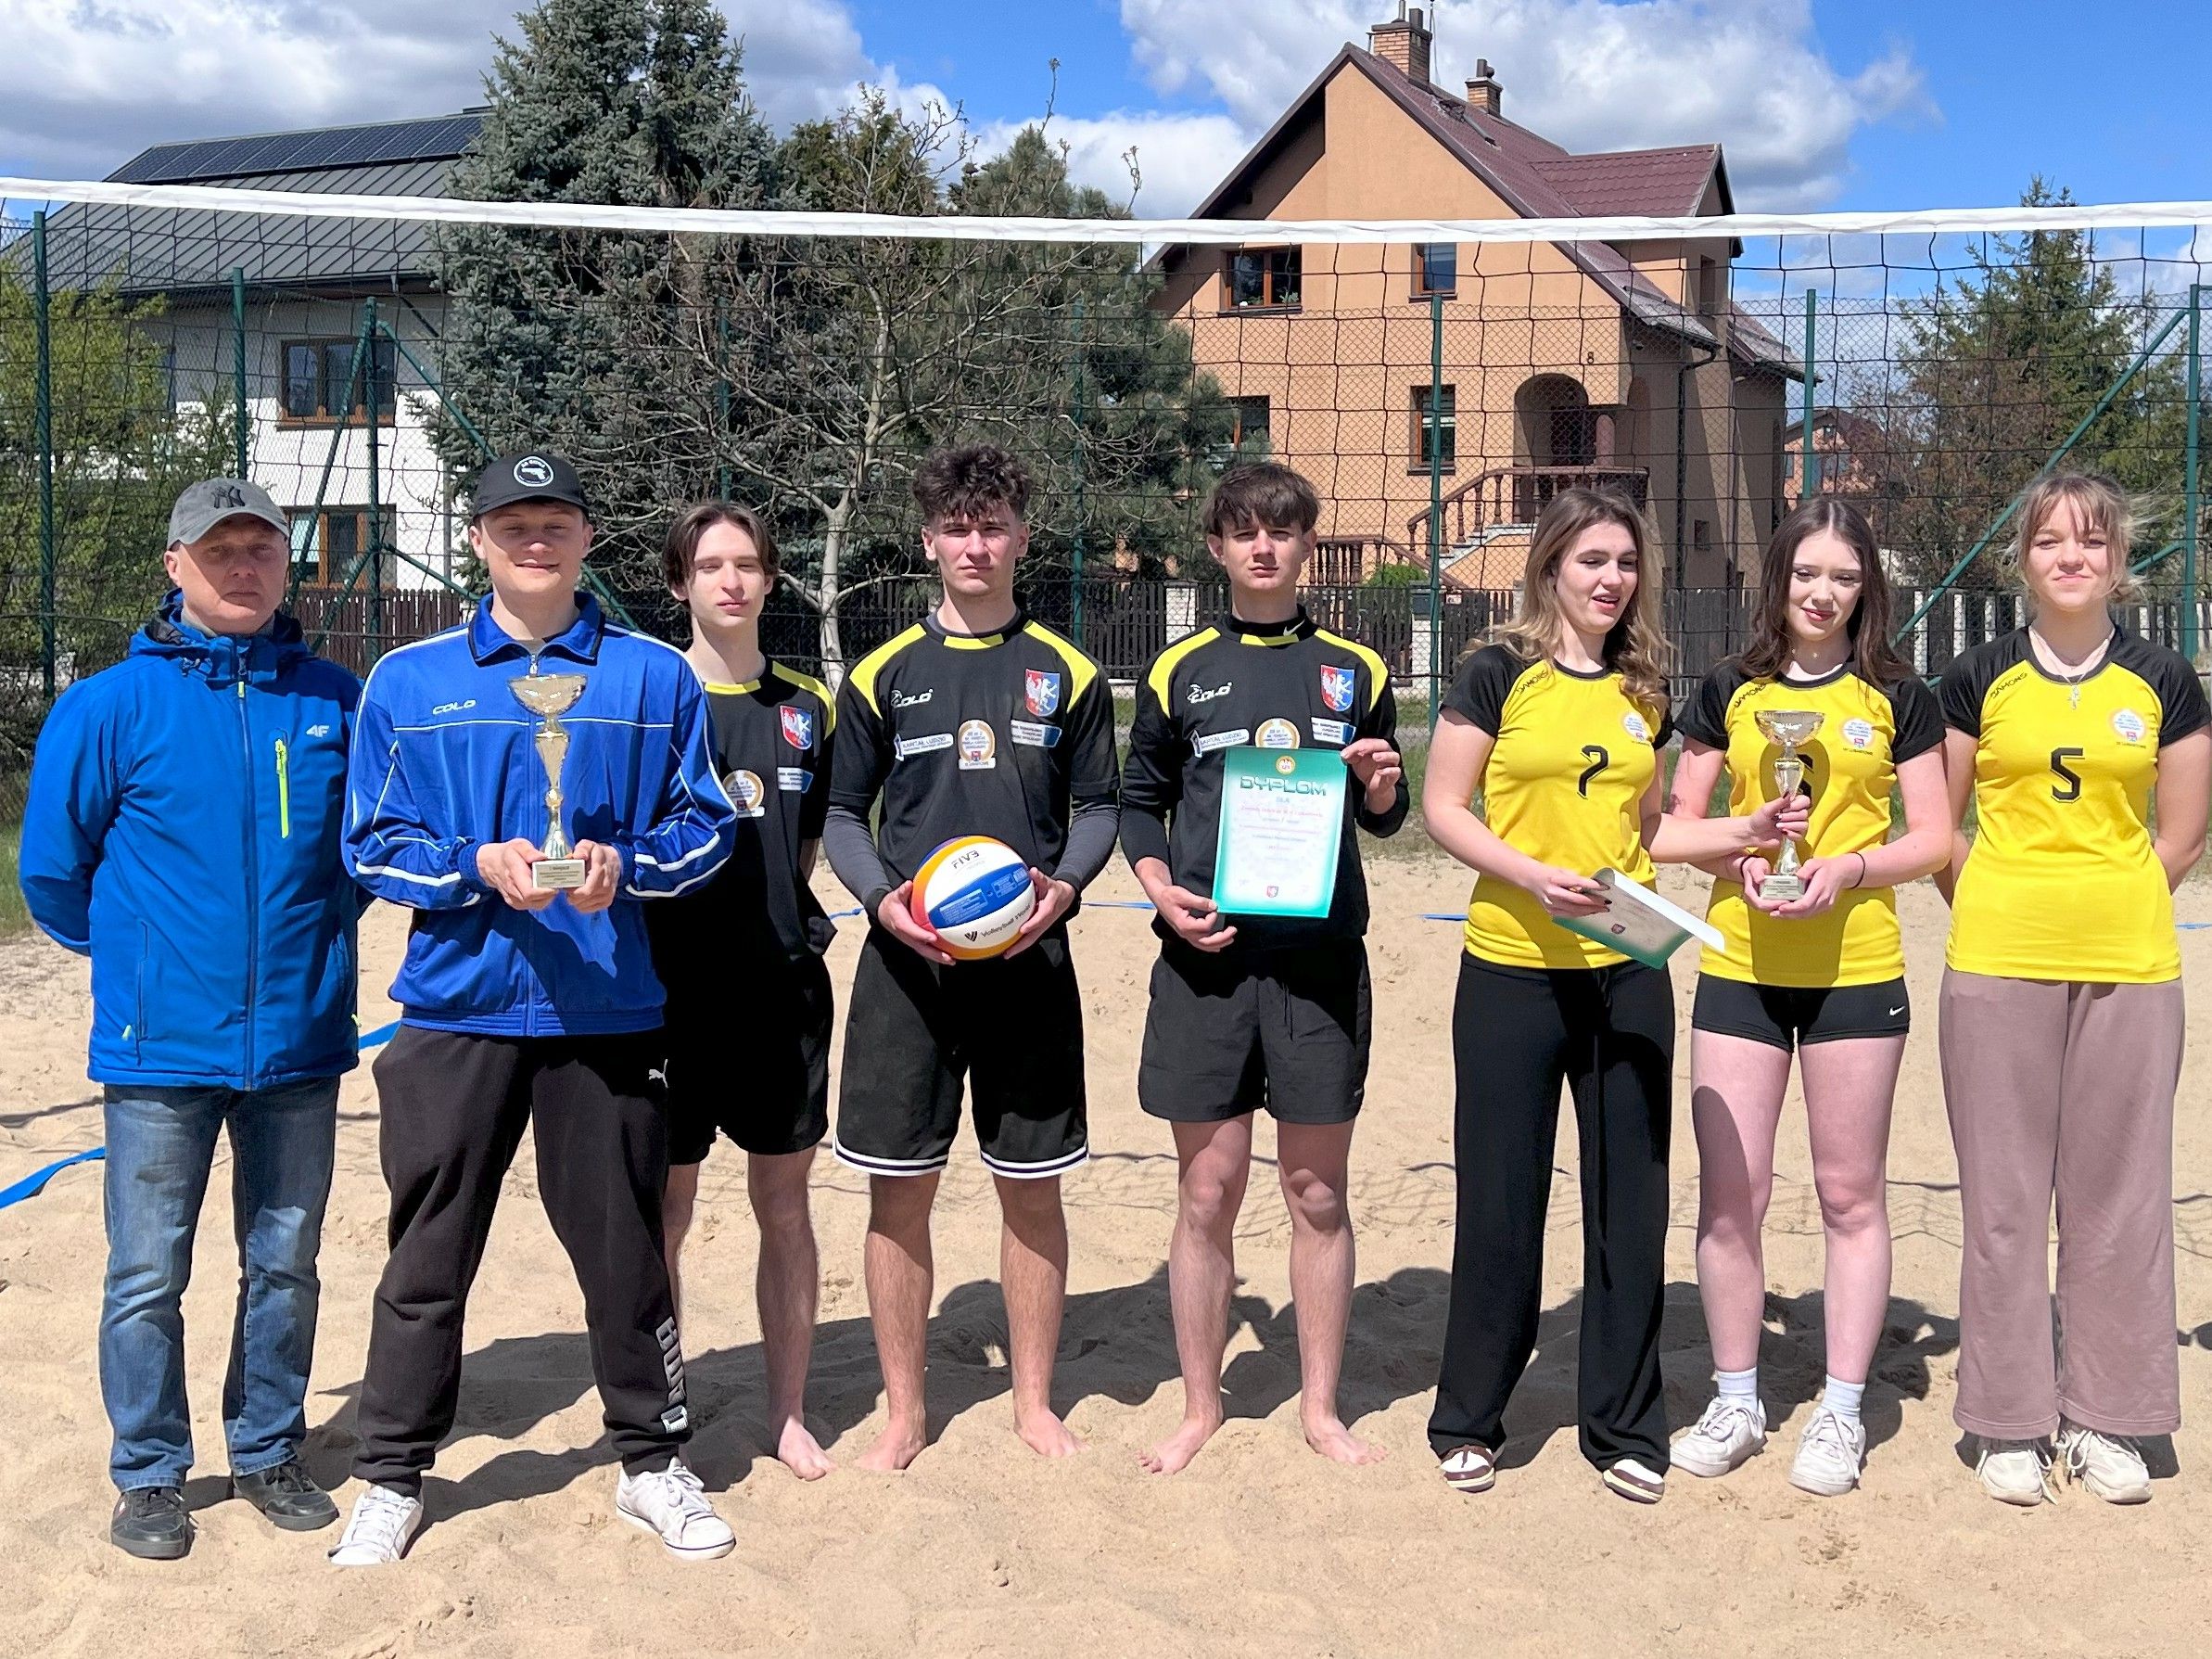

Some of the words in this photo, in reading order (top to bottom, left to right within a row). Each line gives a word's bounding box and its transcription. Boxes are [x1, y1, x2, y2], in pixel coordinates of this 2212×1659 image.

[1586, 351, 1595, 364] 8
[433, 699, 476, 715] COLO
[306, 724, 329, 738] 4F
[2050, 747, 2085, 803] 5
[1239, 775, 1328, 797] DYPLOM
